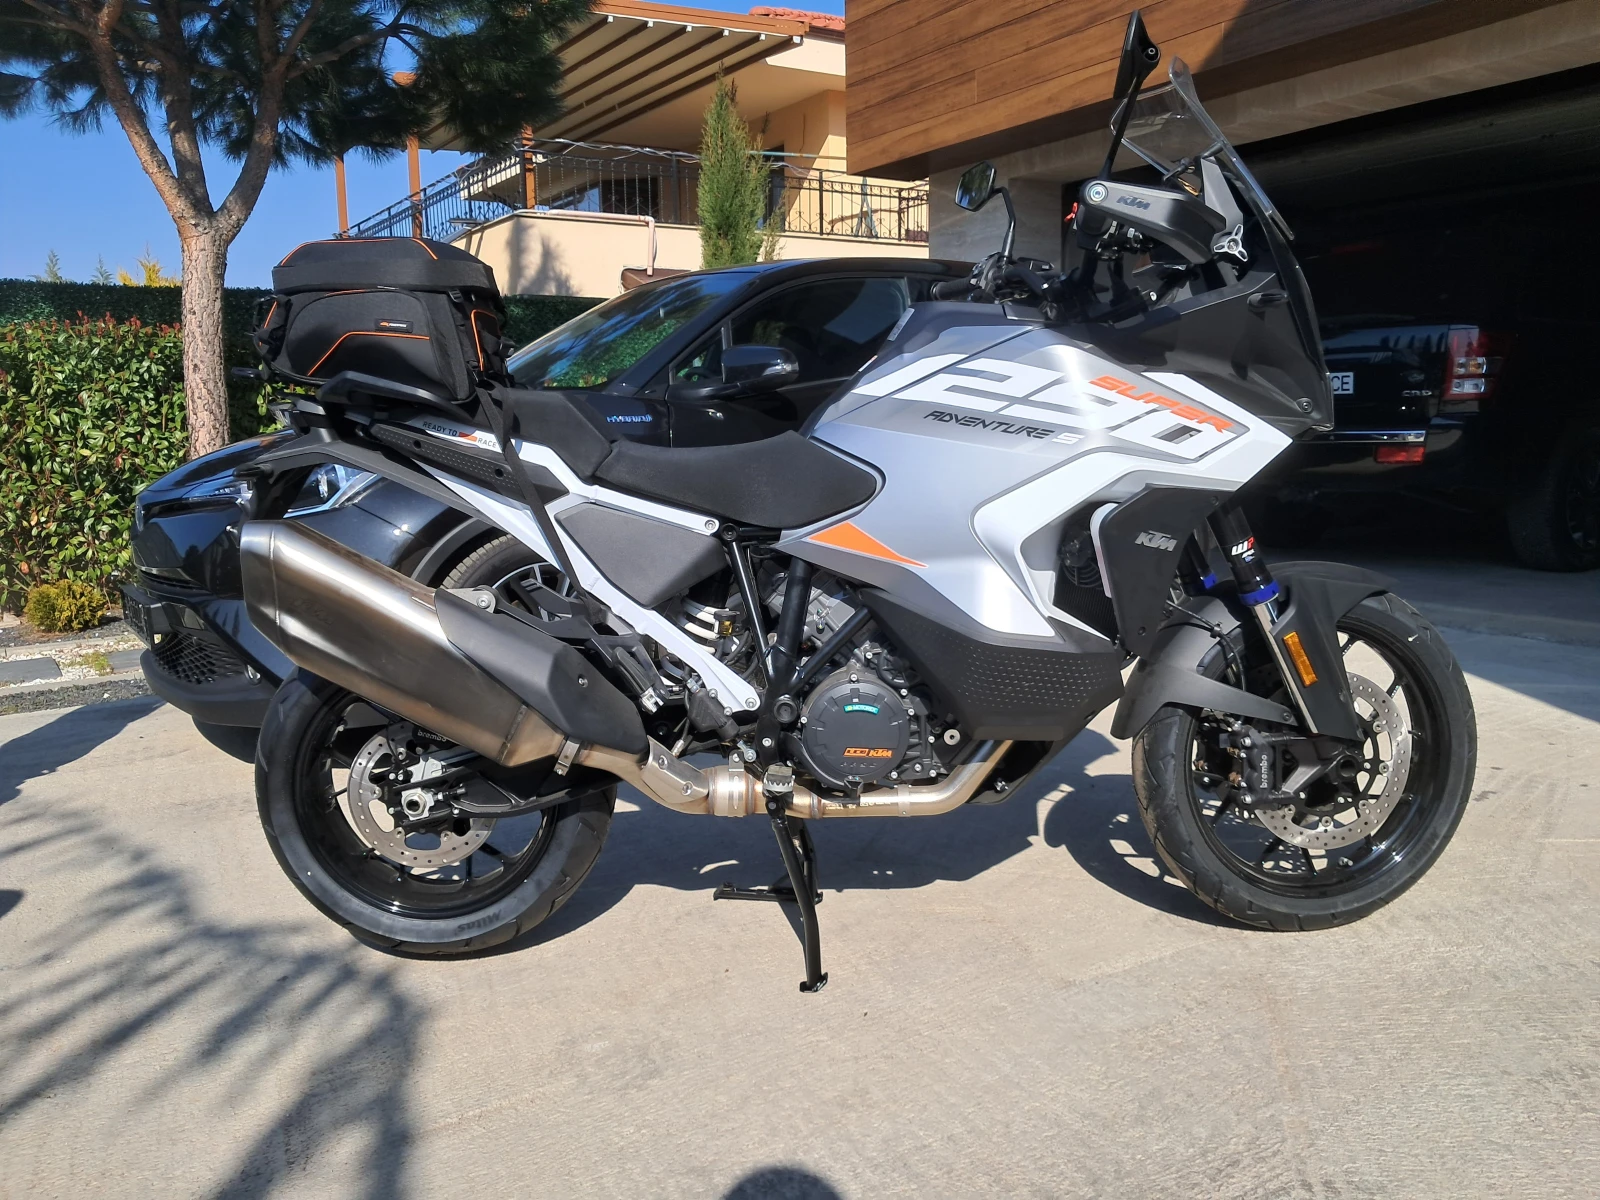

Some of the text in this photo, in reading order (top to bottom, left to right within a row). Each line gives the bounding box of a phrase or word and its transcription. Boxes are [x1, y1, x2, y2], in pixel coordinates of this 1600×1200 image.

[1116, 195, 1151, 211] KTM
[1089, 375, 1236, 434] SUPER
[423, 421, 497, 448] READY TO RACE
[924, 410, 1085, 445] ADVENTURE S
[1135, 530, 1178, 552] KTM
[1231, 536, 1256, 556] WP
[417, 729, 447, 742] brembo
[868, 748, 893, 758] KTM
[1260, 754, 1268, 789] brembo
[457, 909, 502, 933] Mitas
